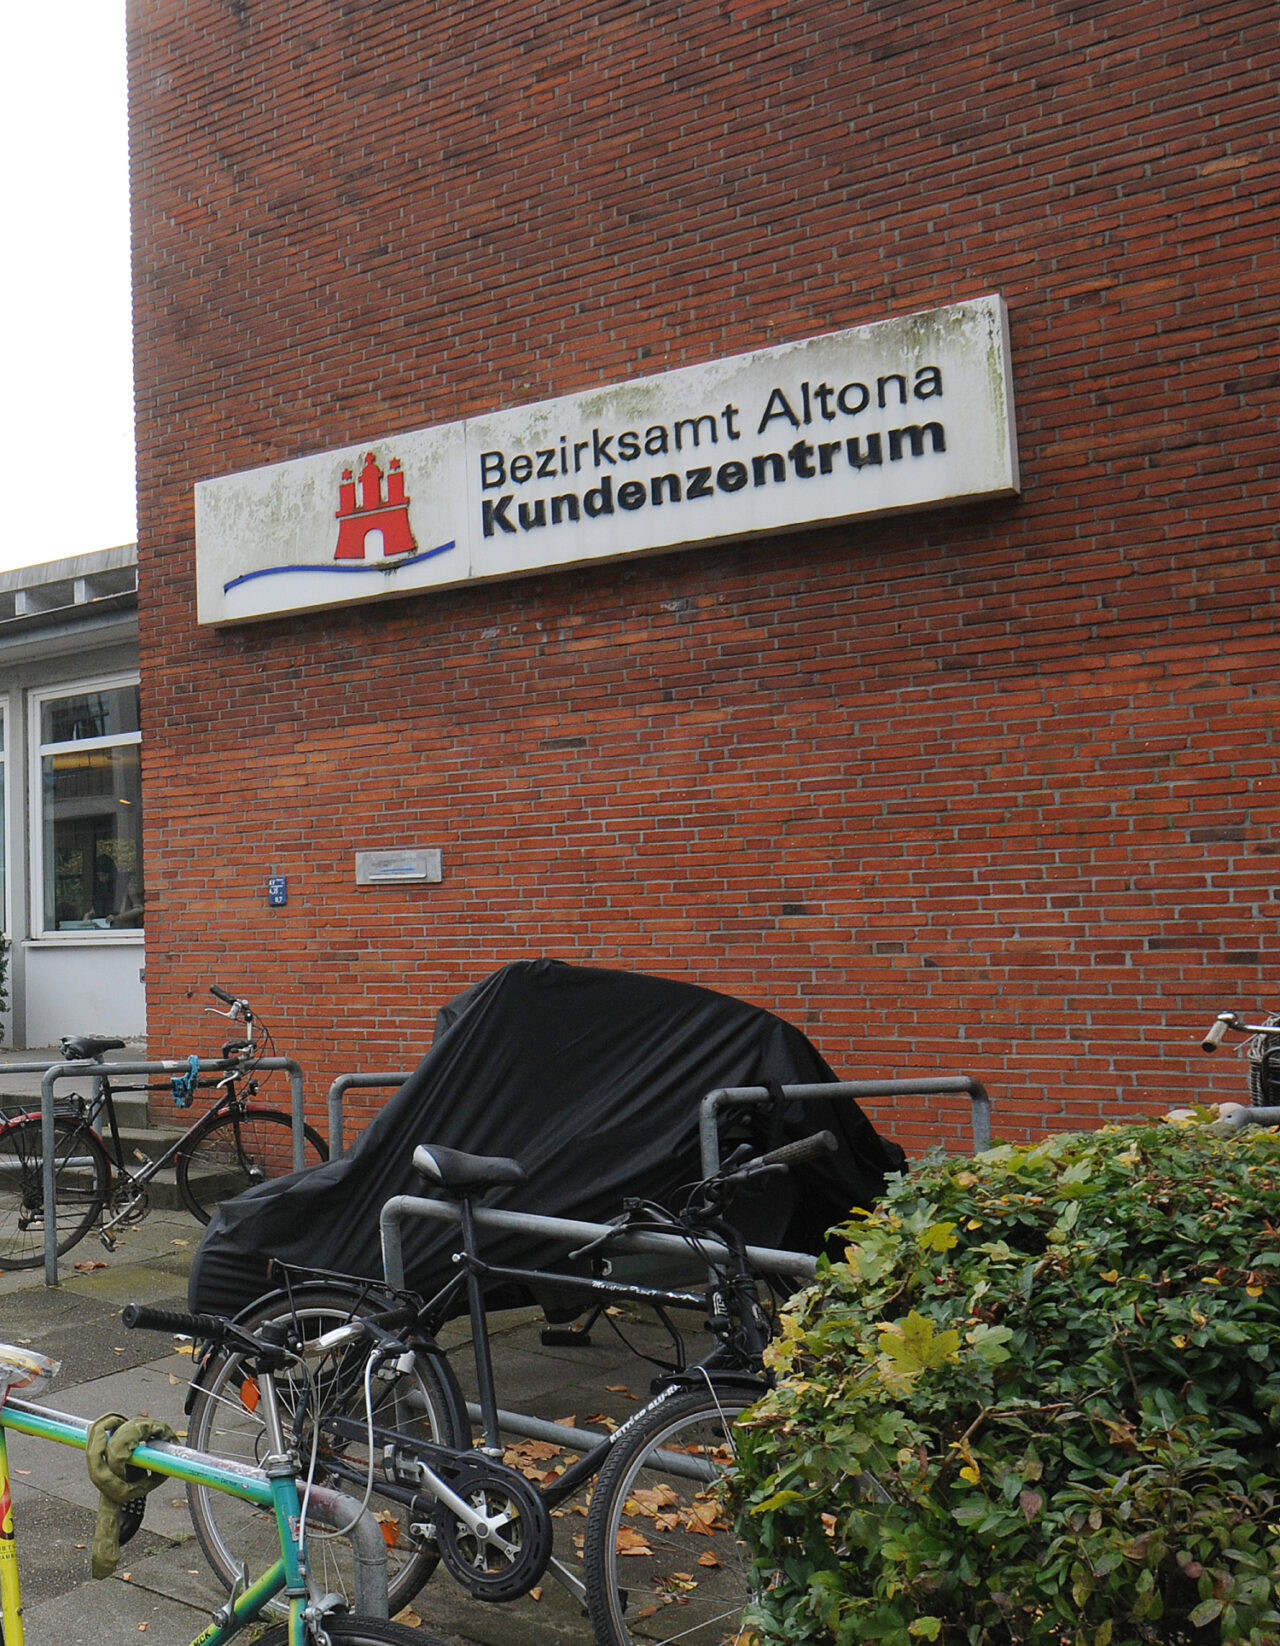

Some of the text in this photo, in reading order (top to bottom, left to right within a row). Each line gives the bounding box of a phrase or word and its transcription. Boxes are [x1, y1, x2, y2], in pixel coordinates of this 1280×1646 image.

[480, 364, 944, 491] Bezirksamt Altona
[481, 420, 946, 537] Kundenzentrum
